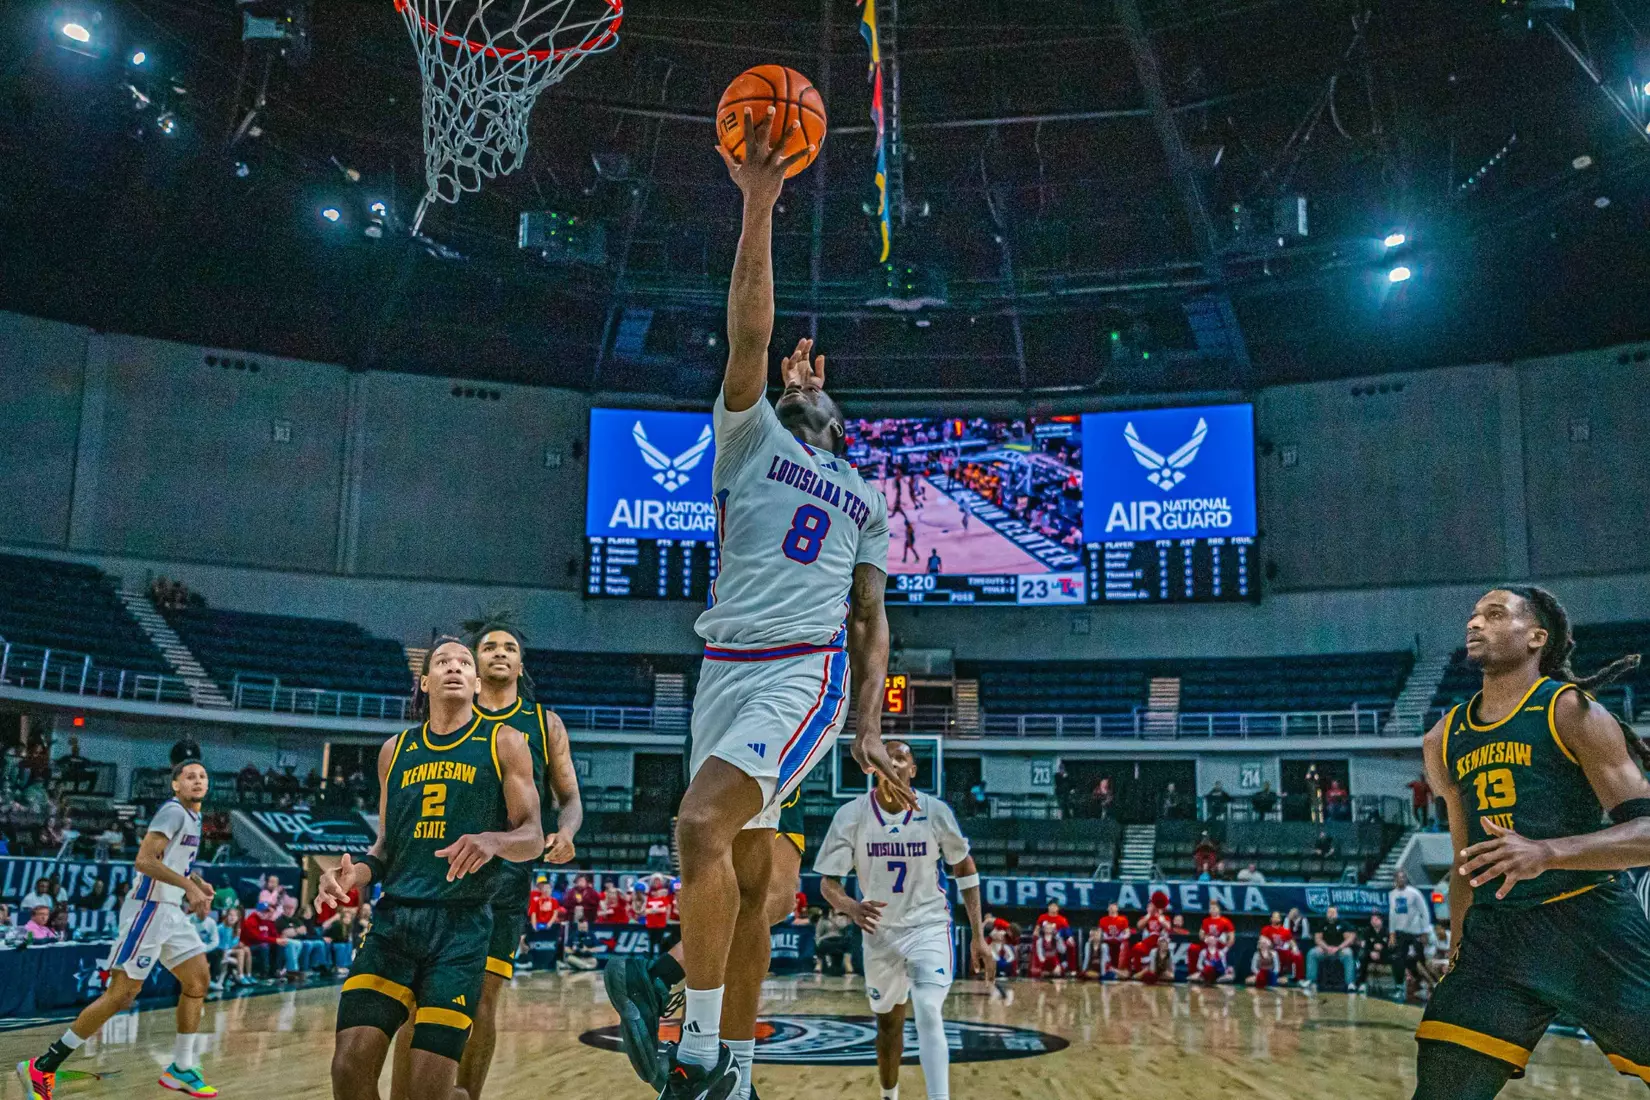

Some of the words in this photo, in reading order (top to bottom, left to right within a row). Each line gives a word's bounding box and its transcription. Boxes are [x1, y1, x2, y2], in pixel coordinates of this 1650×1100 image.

[767, 455, 841, 508] LOUISIANA
[842, 490, 871, 531] TECH
[608, 499, 664, 529] AIR
[666, 501, 714, 514] NATION
[1162, 497, 1231, 512] NATIONAL
[665, 514, 716, 531] GUAR
[1105, 501, 1162, 532] AIR
[1162, 511, 1232, 530] GUARD
[781, 503, 832, 566] 8
[995, 520, 1080, 568] CENTER
[1105, 541, 1134, 549] PLAYER
[1156, 540, 1171, 548] PTS
[896, 575, 936, 591] 3:20
[1022, 580, 1048, 599] 23
[1456, 741, 1532, 780] KENNESAW
[401, 761, 477, 789] KENNESAW
[1033, 767, 1050, 784] 213
[1242, 769, 1260, 787] 214
[1473, 768, 1516, 811] 13
[421, 783, 447, 817] 2
[252, 810, 323, 834] VBC
[414, 821, 446, 839] STATE
[1484, 812, 1515, 832] ATE
[285, 843, 371, 852] HUNTSVILL
[866, 843, 906, 857] LOUISIANA
[906, 842, 927, 857] TECH
[2, 861, 99, 898] LIMITS
[887, 861, 907, 894] 7
[1331, 889, 1389, 906] HUNTSVILL
[770, 934, 800, 949] VILLE
